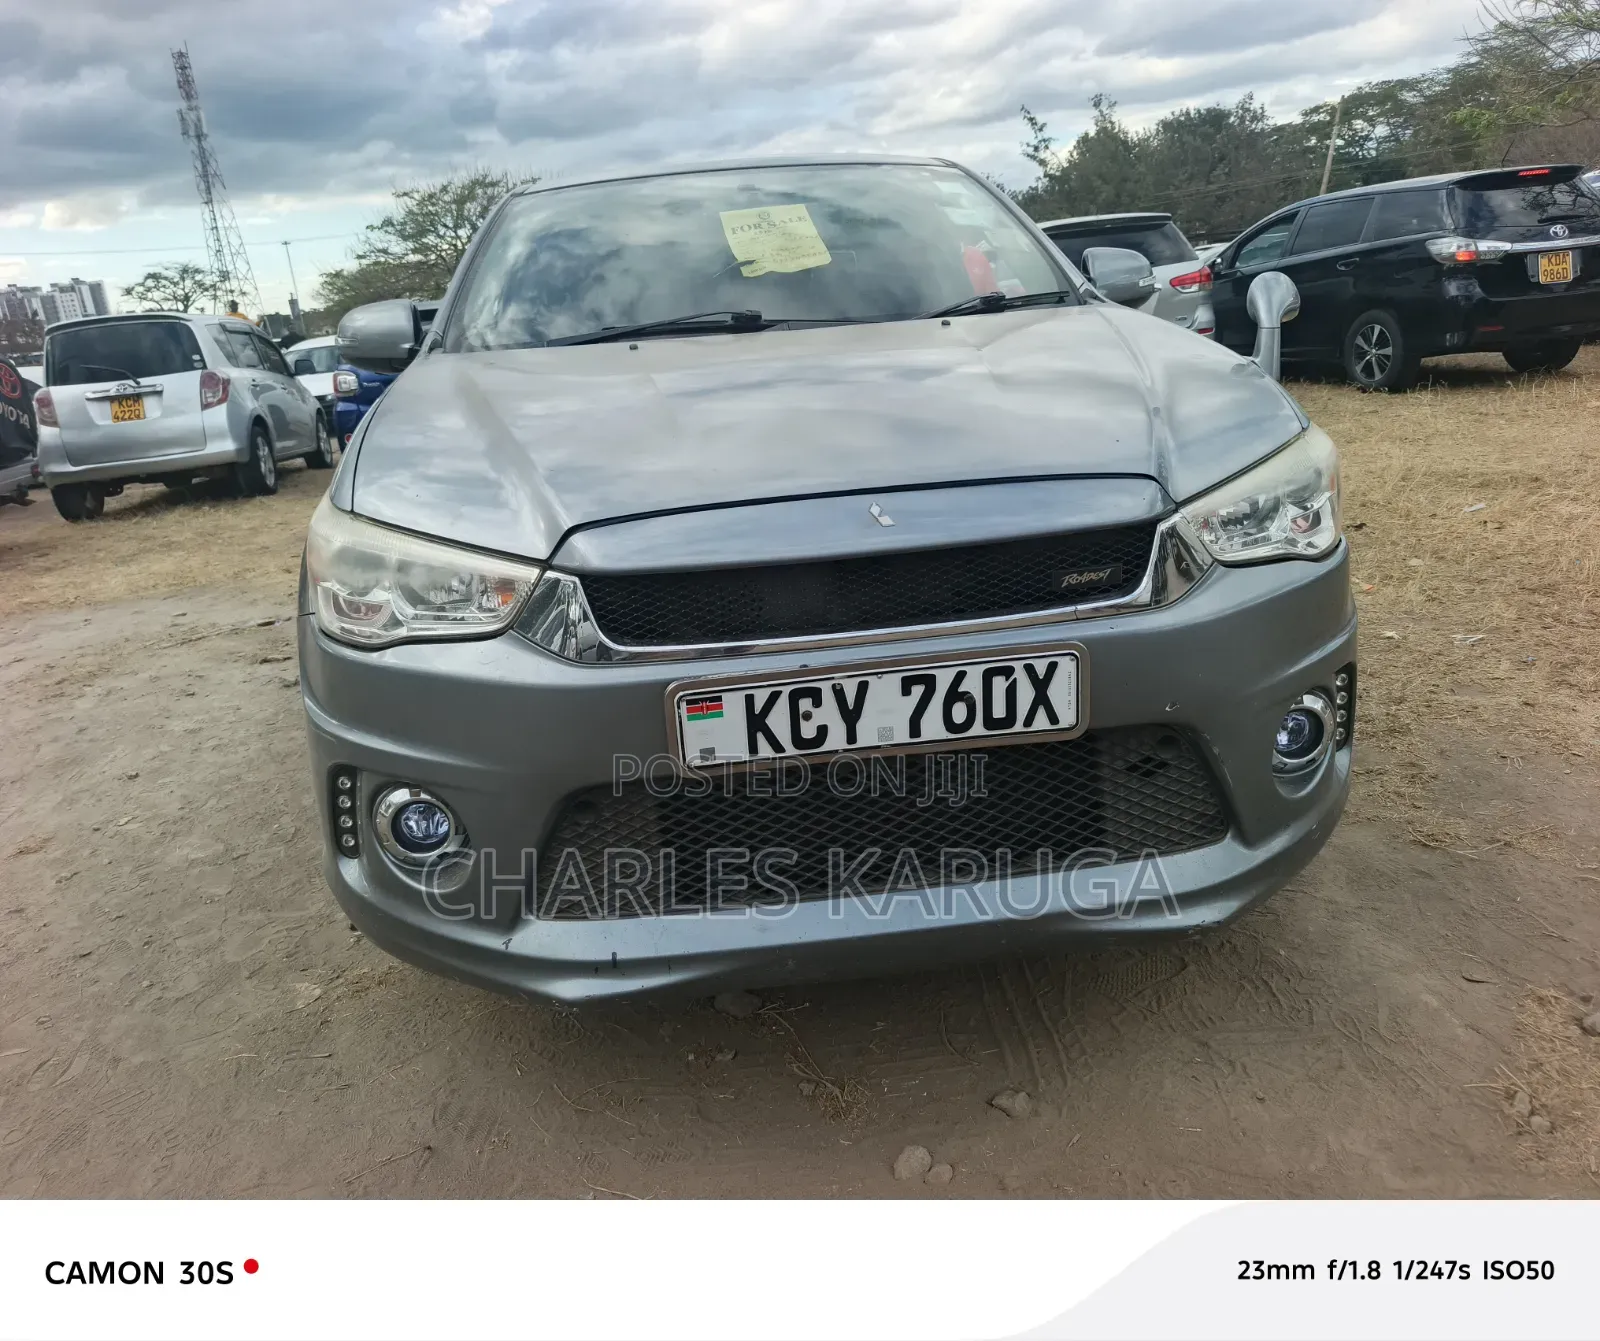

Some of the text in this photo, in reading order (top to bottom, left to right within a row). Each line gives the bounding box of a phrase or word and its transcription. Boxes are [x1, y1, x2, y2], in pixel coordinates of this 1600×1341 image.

[730, 215, 808, 236] FOR SALE
[1547, 254, 1568, 267] KDA
[1542, 268, 1569, 282] 986D
[744, 680, 869, 756] KCY
[901, 660, 1060, 738] 760X
